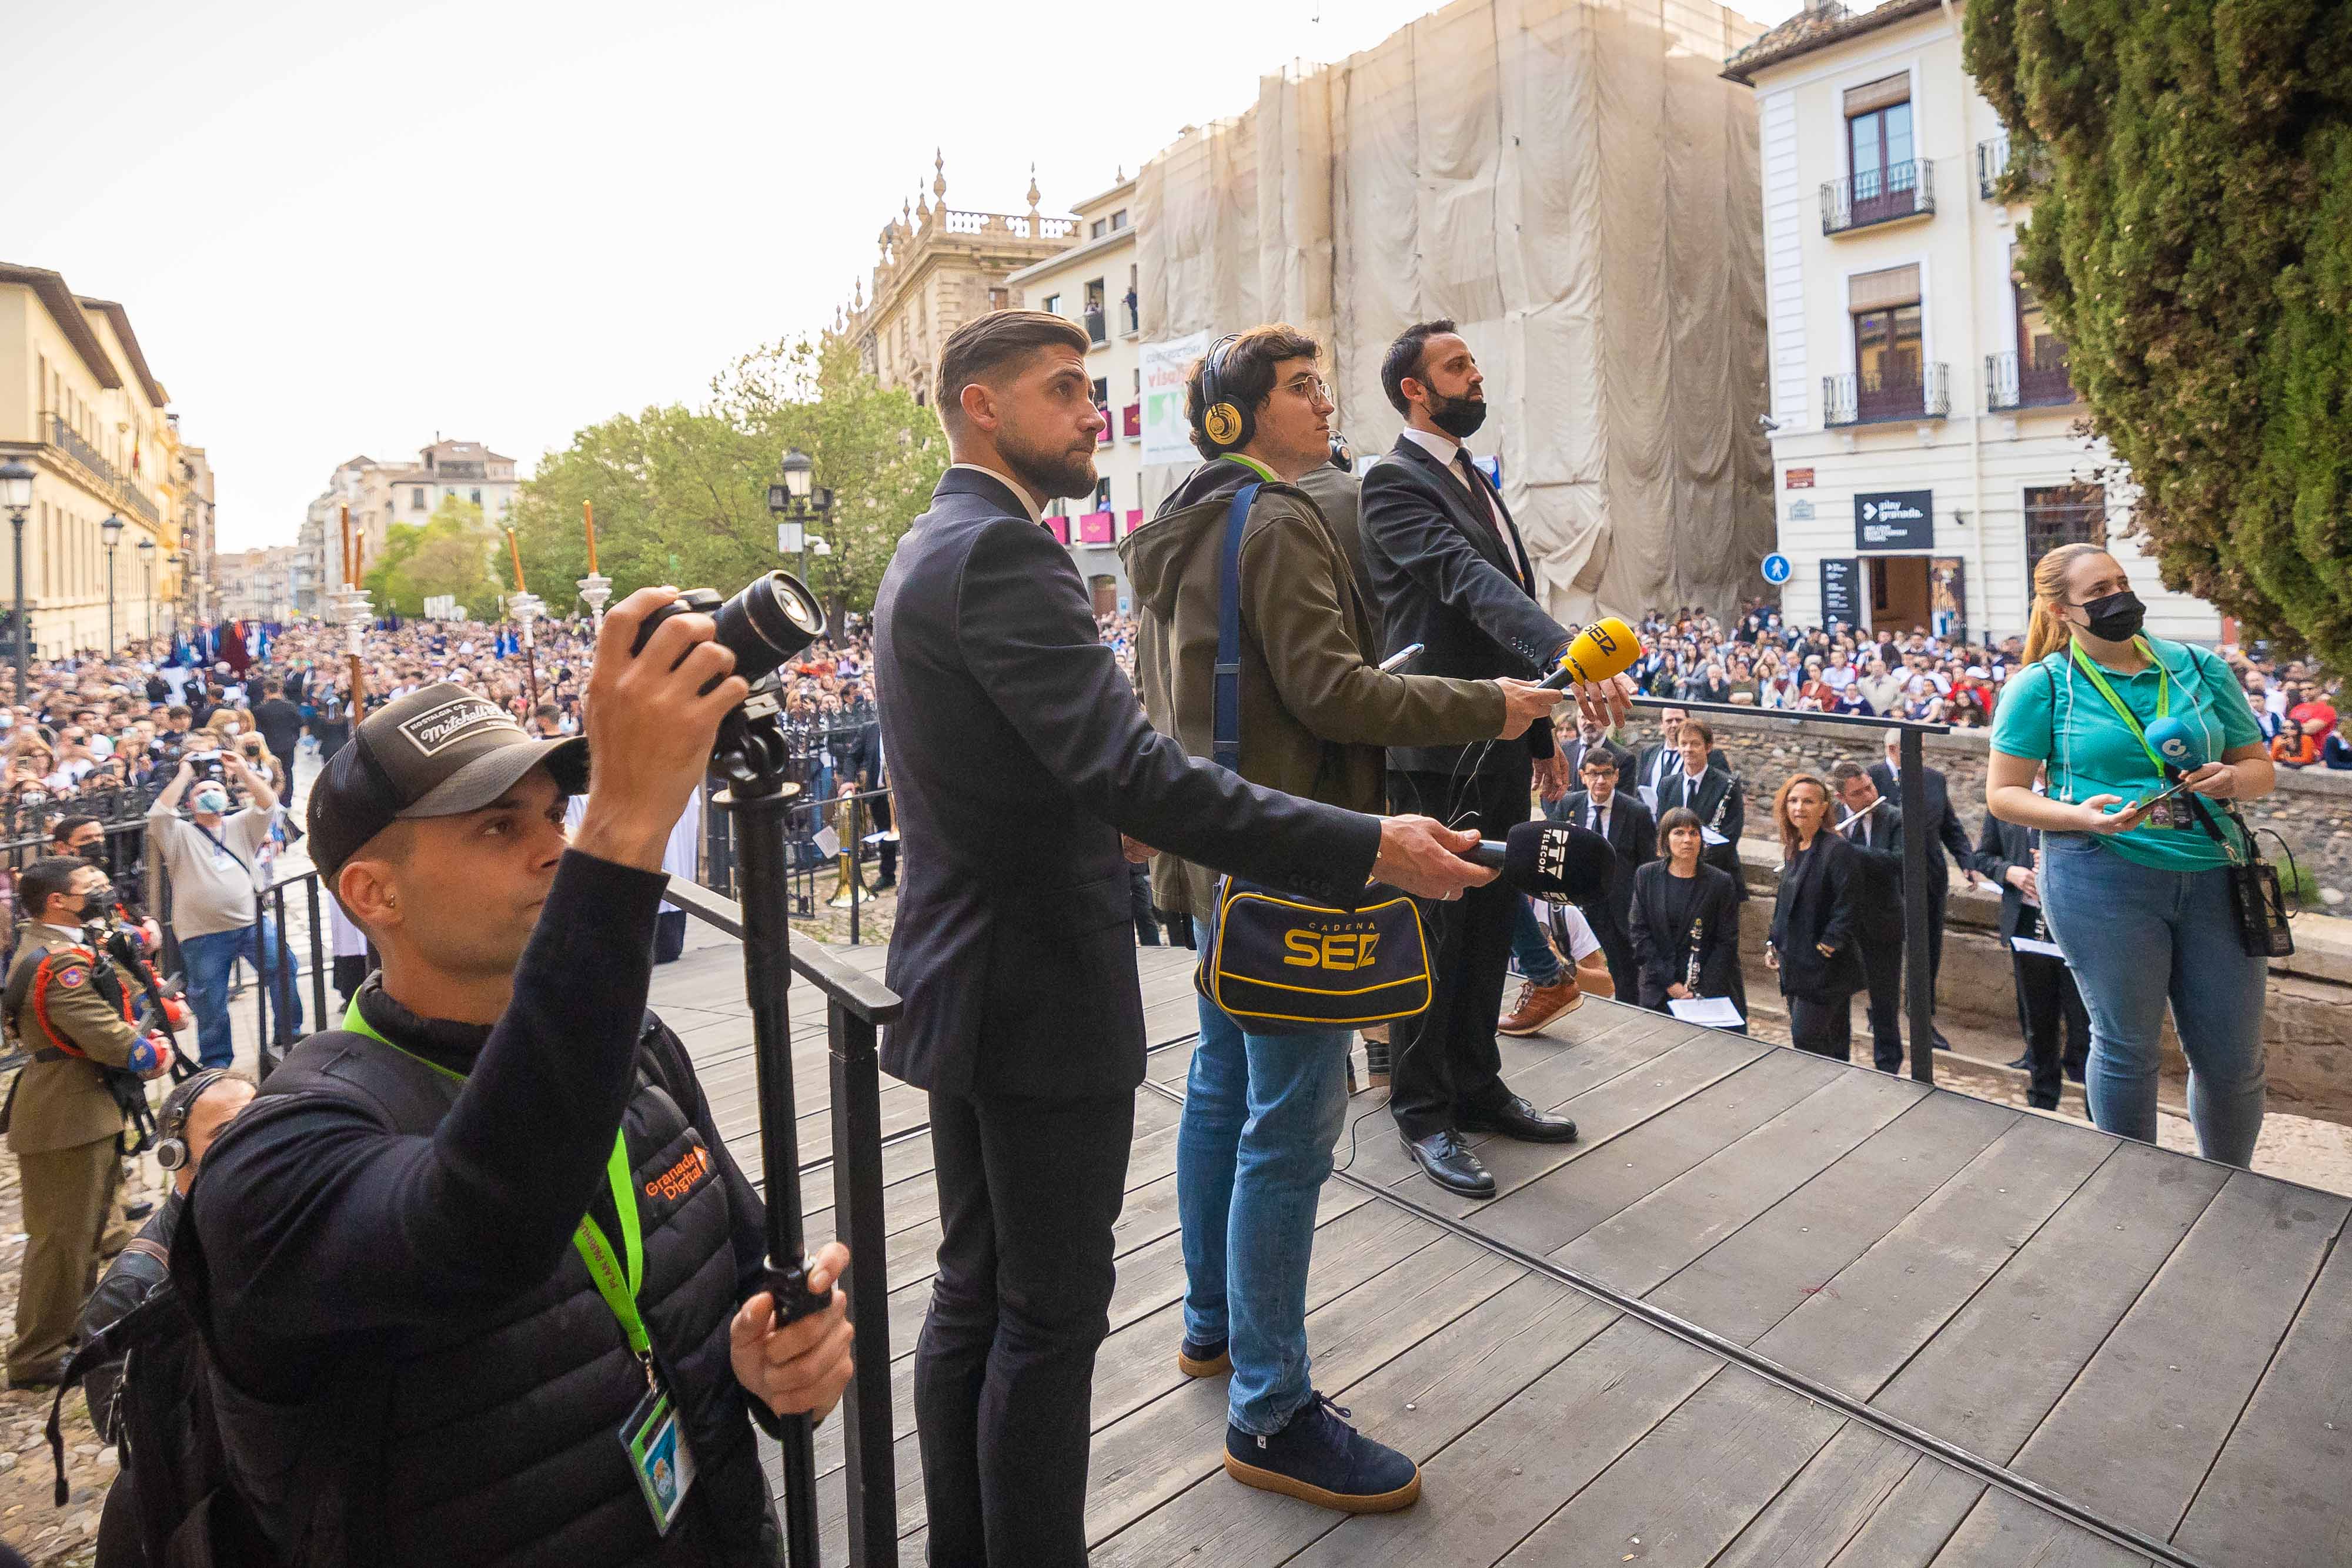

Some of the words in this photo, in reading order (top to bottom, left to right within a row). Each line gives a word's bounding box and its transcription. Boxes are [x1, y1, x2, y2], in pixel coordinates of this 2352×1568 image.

[1878, 499, 1901, 511] play
[410, 708, 453, 730] NOSTALGIA
[1538, 828, 1552, 873] TELECOM
[1546, 829, 1569, 880] PTV
[1309, 922, 1375, 932] CADENA
[1284, 928, 1381, 971] SER
[646, 1153, 697, 1196] Granada
[663, 1164, 702, 1201] Digital
